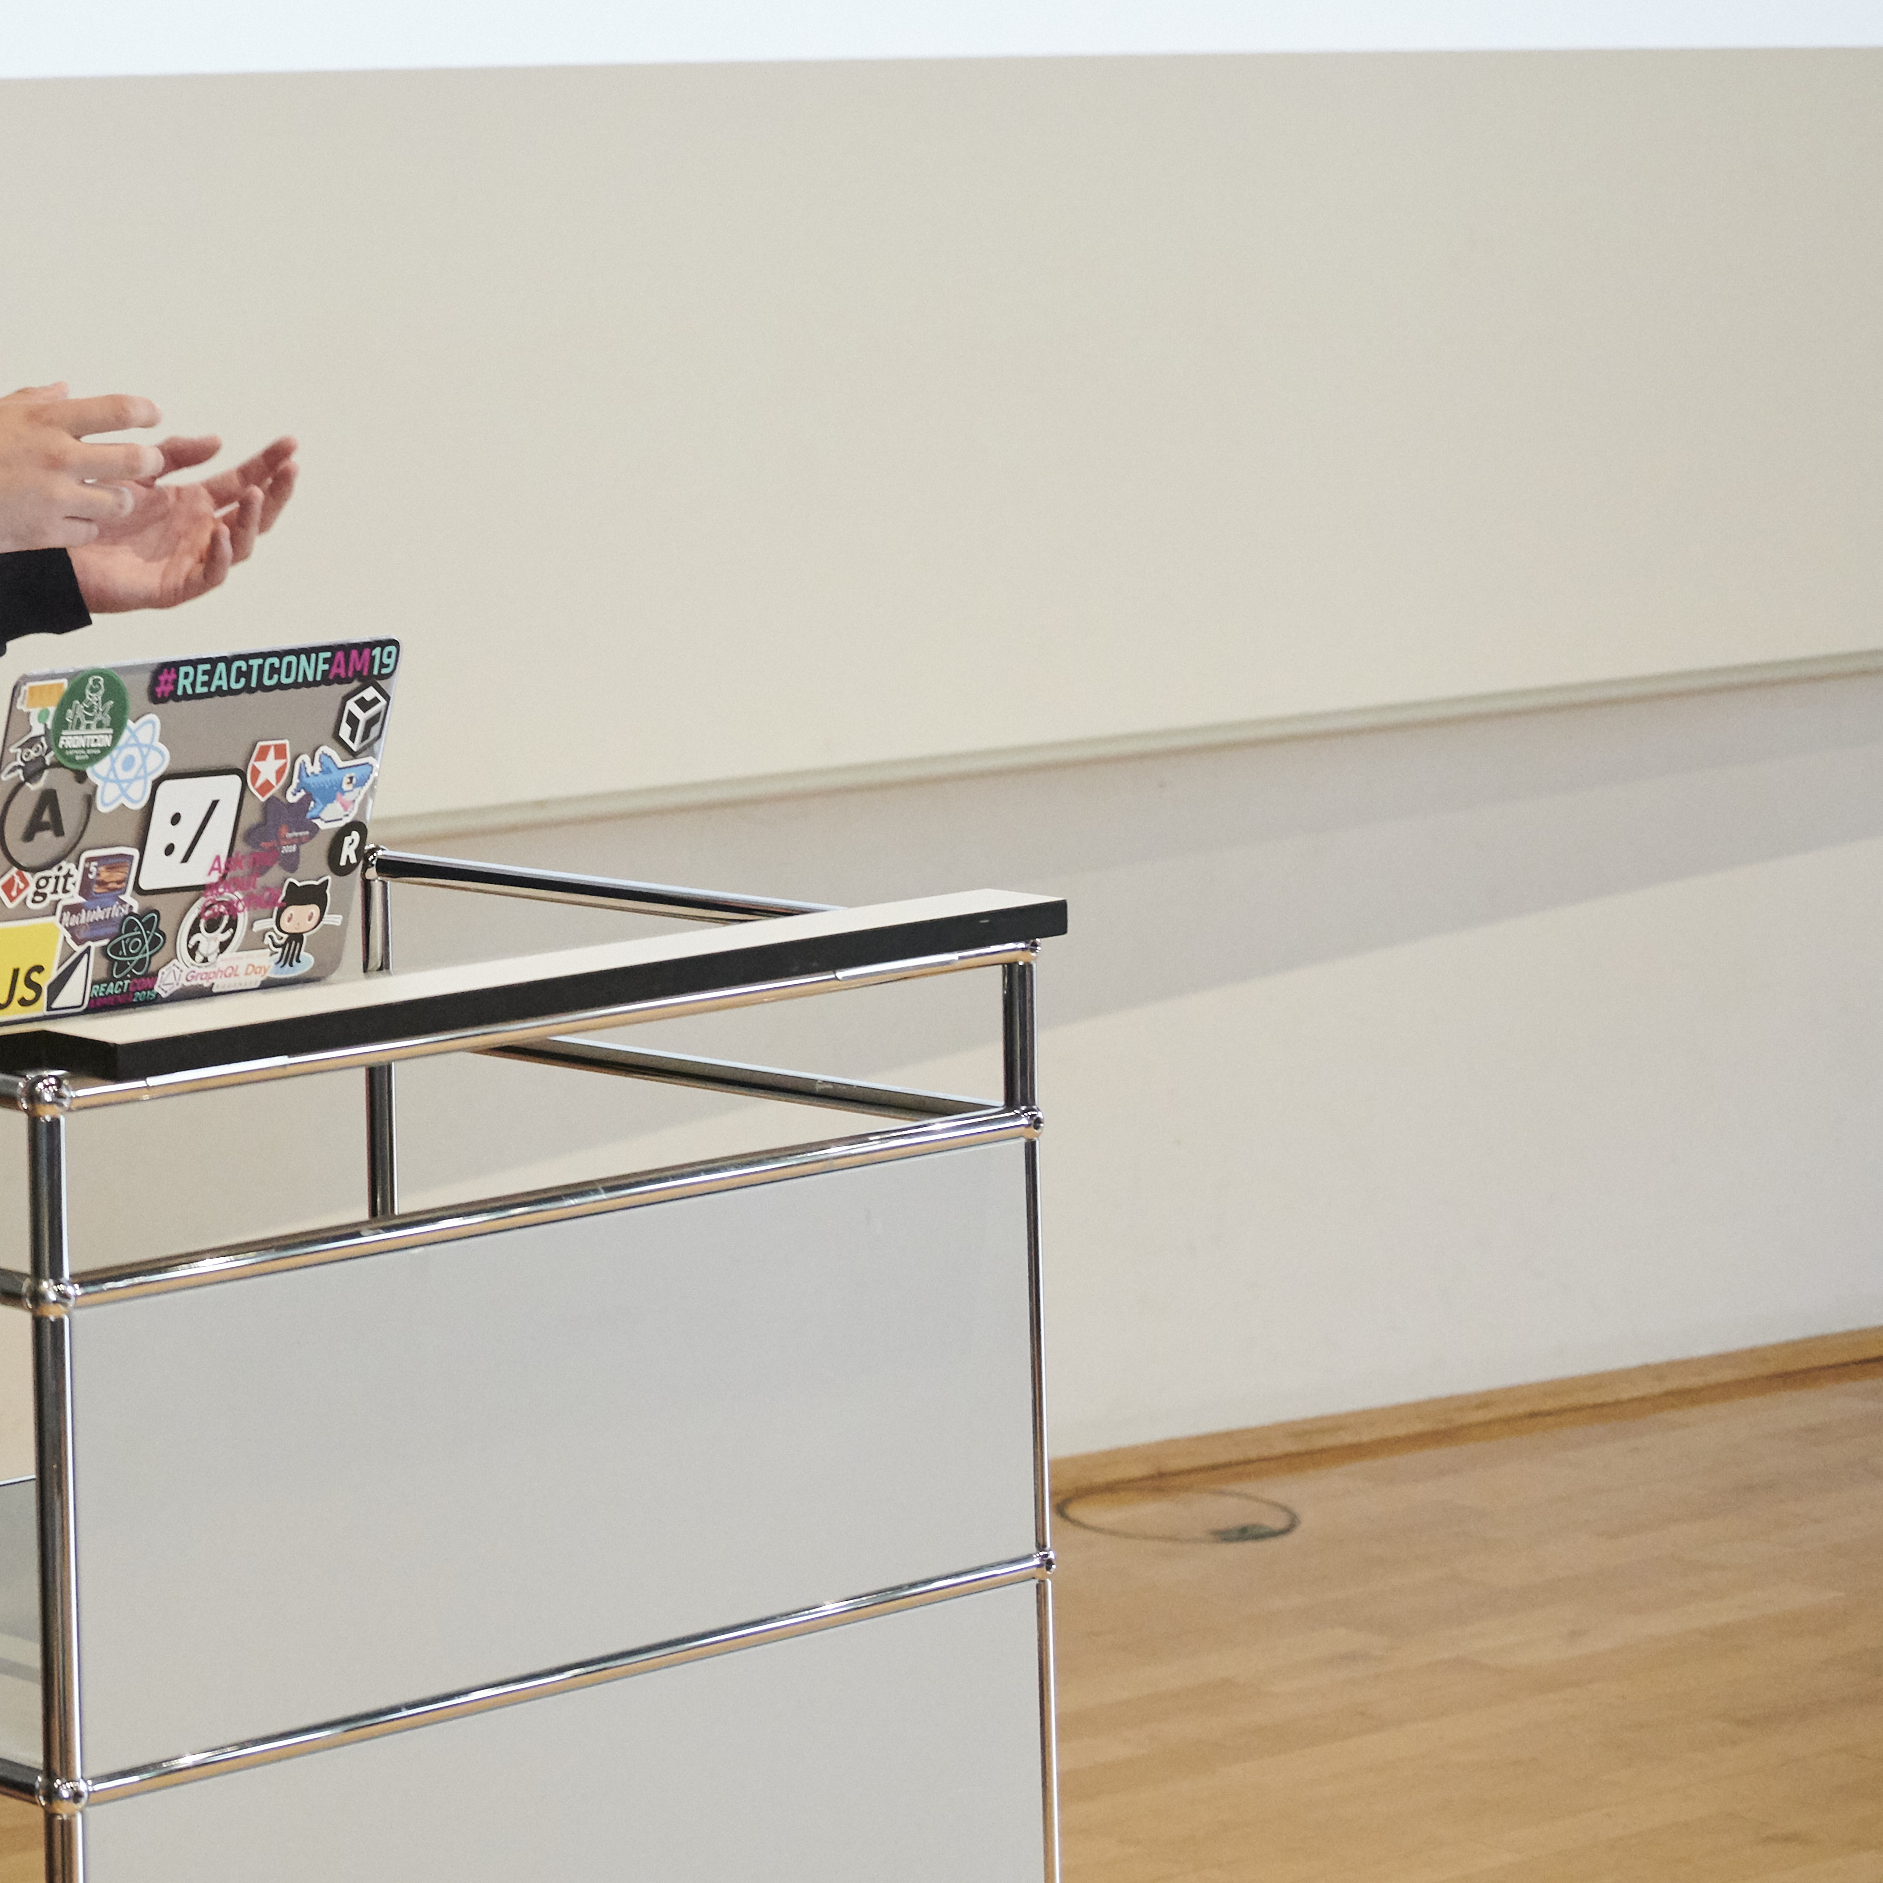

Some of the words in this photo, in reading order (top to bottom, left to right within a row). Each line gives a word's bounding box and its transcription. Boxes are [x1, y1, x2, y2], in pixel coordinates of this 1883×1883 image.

[155, 645, 398, 698] #REACTCONFAM19
[31, 864, 75, 904] git
[185, 965, 240, 983] GraphQL
[244, 963, 271, 977] Day
